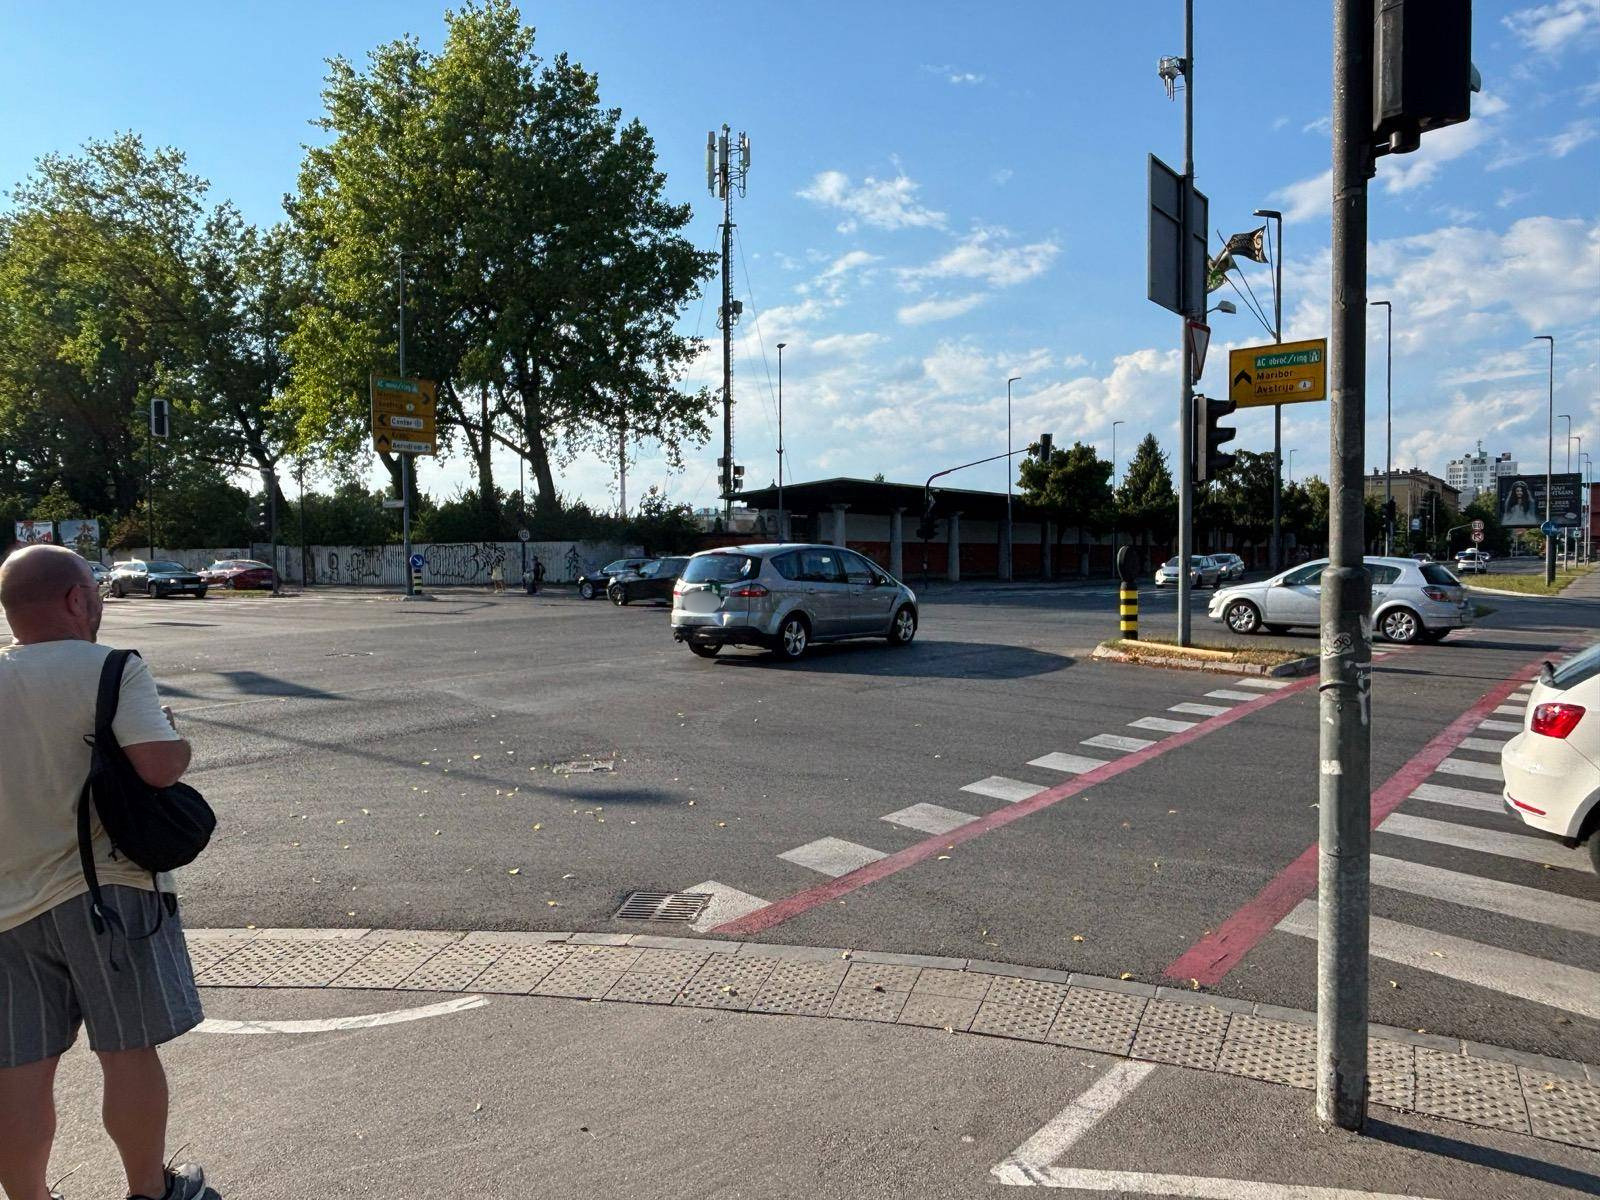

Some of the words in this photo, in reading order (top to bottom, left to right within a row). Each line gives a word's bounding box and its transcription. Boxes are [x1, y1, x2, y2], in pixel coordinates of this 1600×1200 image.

[1256, 358, 1266, 367] AC
[1256, 370, 1292, 380] Maribor
[1256, 383, 1294, 394] Avstrija
